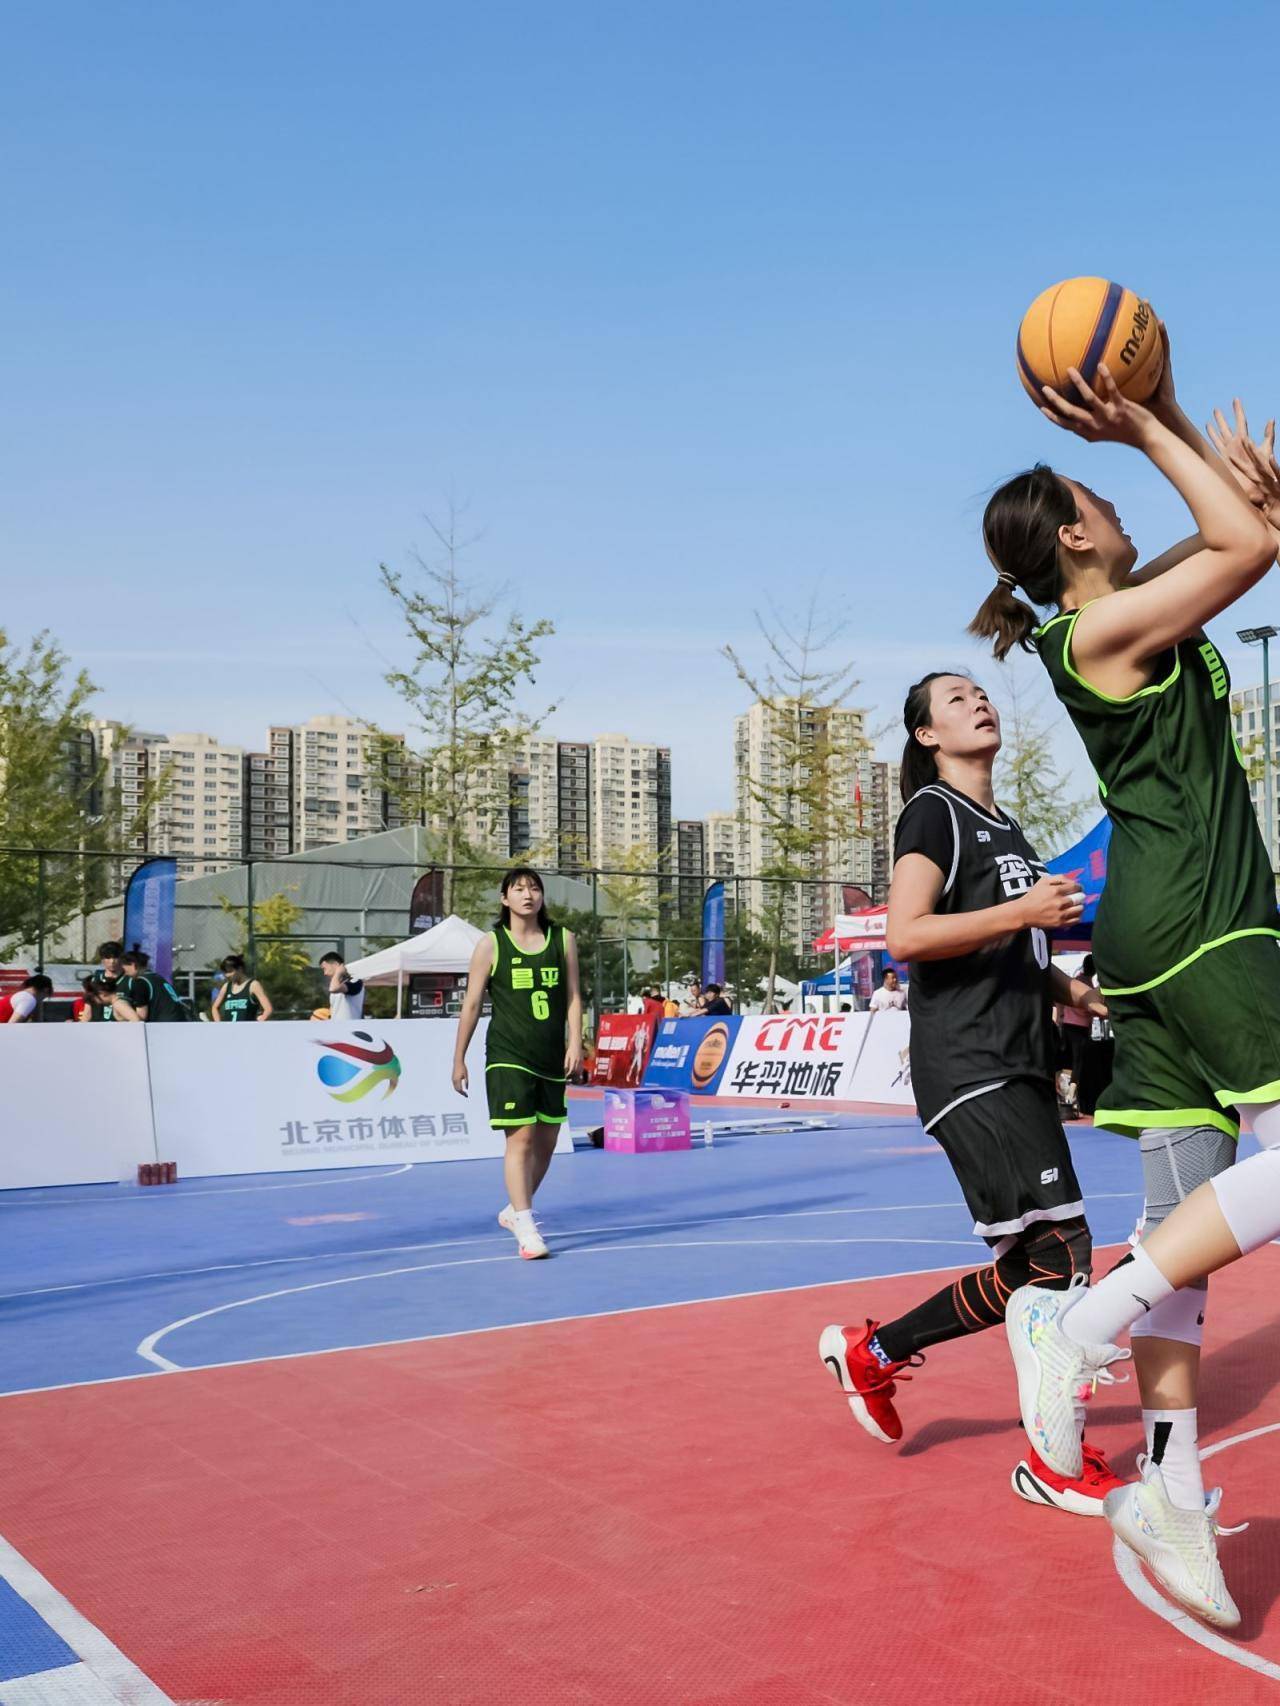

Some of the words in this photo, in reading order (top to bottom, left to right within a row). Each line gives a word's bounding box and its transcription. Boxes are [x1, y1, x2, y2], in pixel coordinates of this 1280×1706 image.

[1120, 297, 1149, 366] molte
[511, 967, 559, 990] 昌平
[531, 990, 550, 1021] 6
[754, 1016, 846, 1051] CME
[731, 1060, 844, 1097] 华羿地板
[280, 1112, 469, 1146] 北京市体育局
